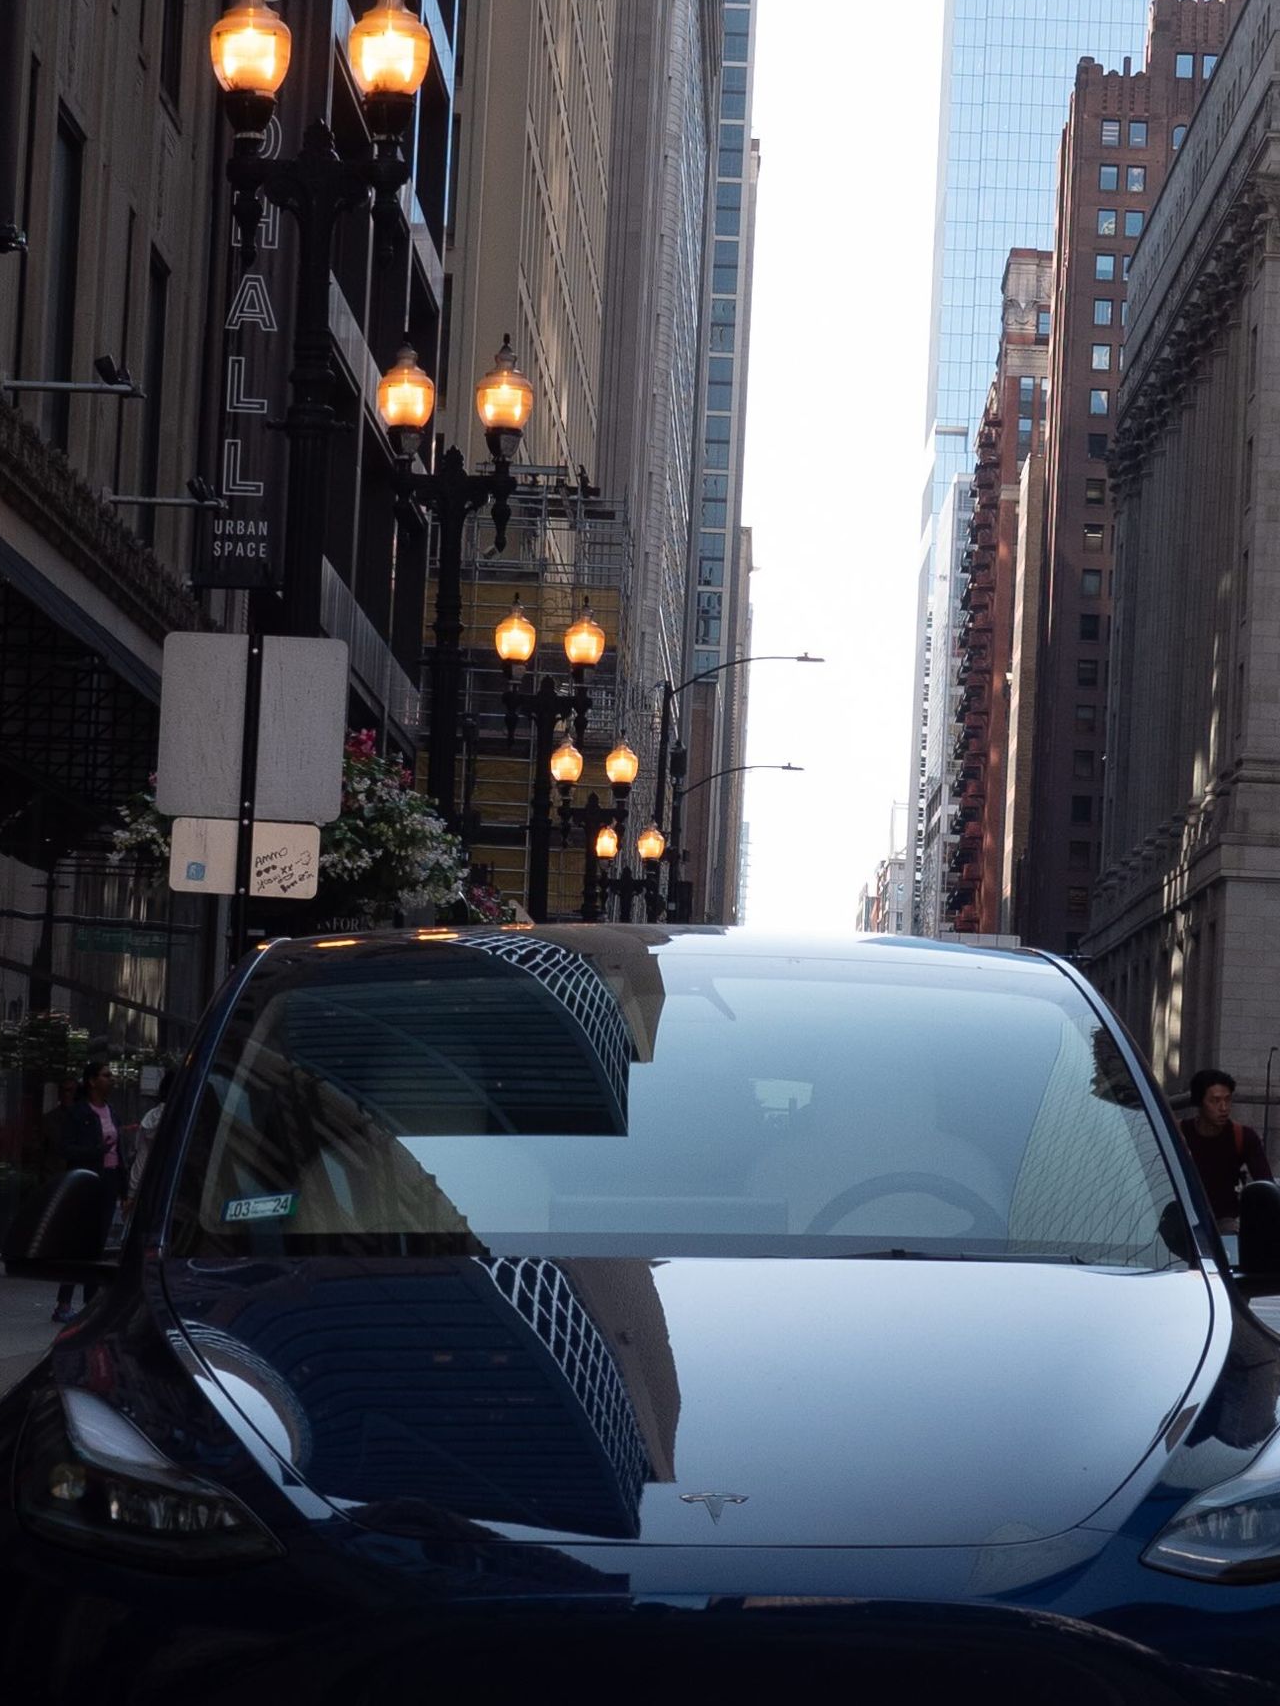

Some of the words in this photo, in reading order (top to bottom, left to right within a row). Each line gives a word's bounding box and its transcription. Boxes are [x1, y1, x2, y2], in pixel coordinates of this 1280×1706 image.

[213, 519, 269, 536] URBAN
[212, 540, 268, 558] SPACE
[272, 1196, 289, 1213] 24
